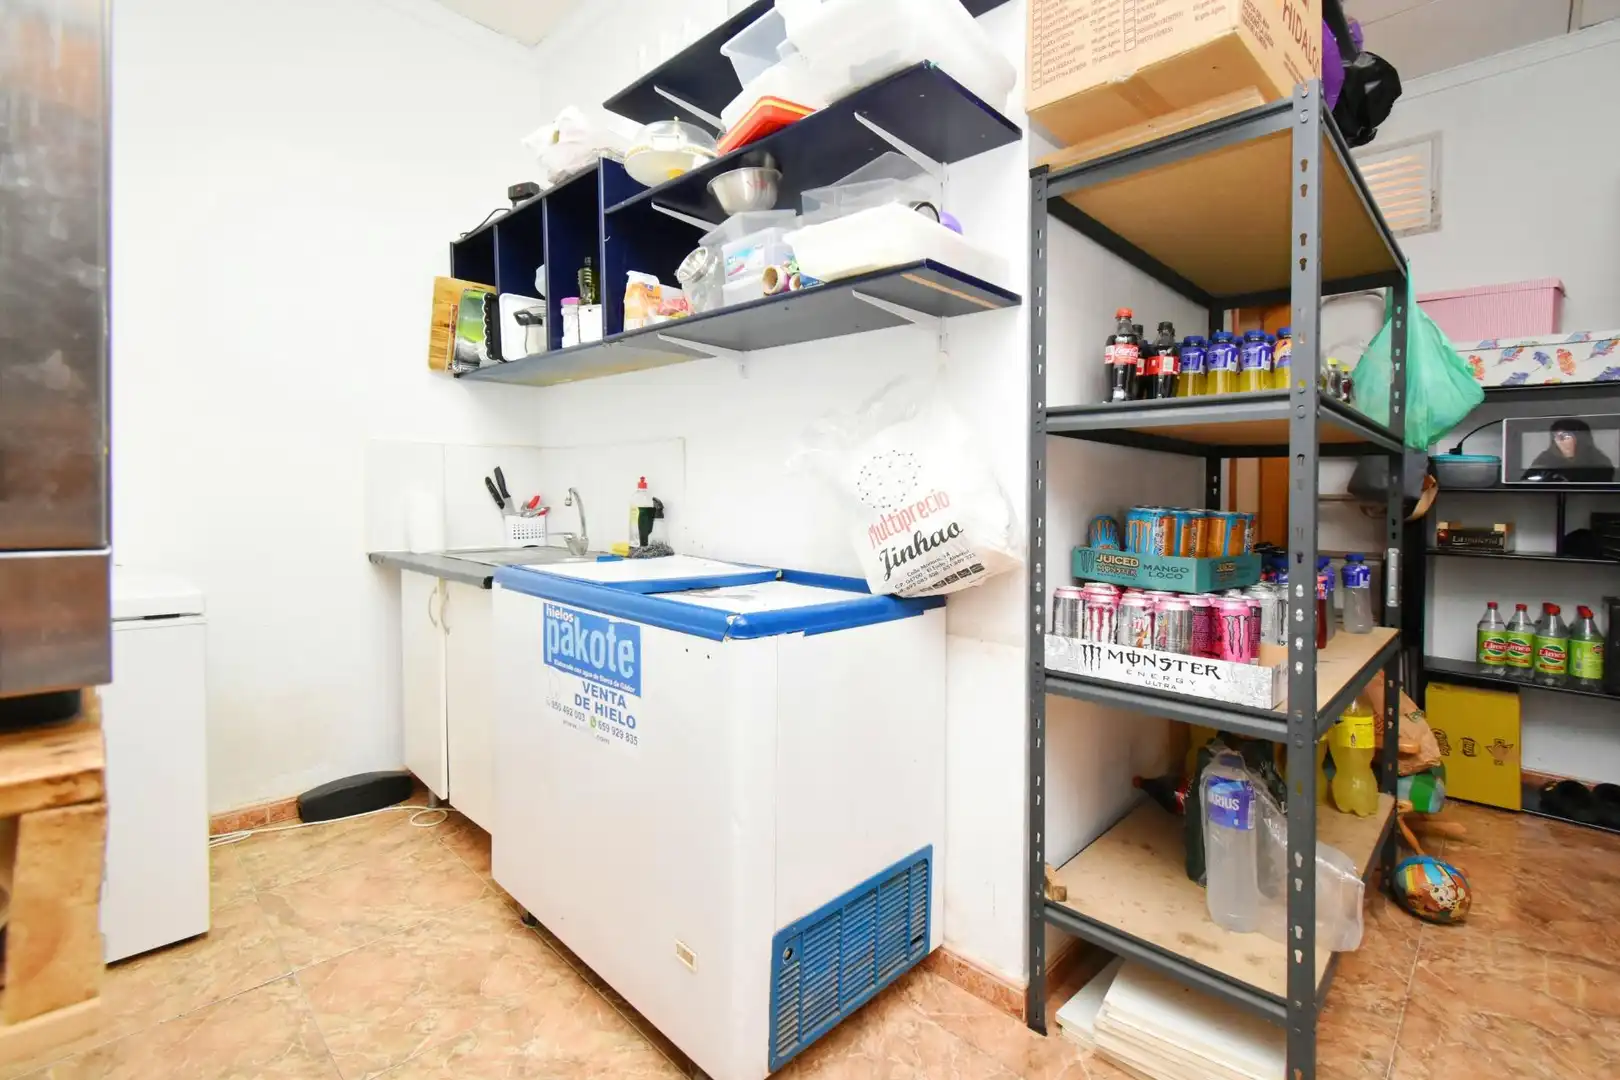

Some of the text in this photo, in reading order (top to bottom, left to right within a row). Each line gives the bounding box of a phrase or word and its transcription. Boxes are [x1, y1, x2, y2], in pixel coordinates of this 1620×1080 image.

[867, 489, 950, 550] Multiprecio
[878, 521, 964, 582] Jinhao
[1096, 554, 1139, 567] JUICED
[1143, 564, 1190, 574] MANGO
[1148, 571, 1184, 580] LOCO
[546, 616, 635, 679] pakote
[1107, 648, 1221, 680] MONSTER
[1126, 669, 1197, 686] ENERGY
[582, 680, 627, 709] VENTA
[1145, 679, 1177, 691] ULTRA
[574, 693, 636, 730] DE HIELO
